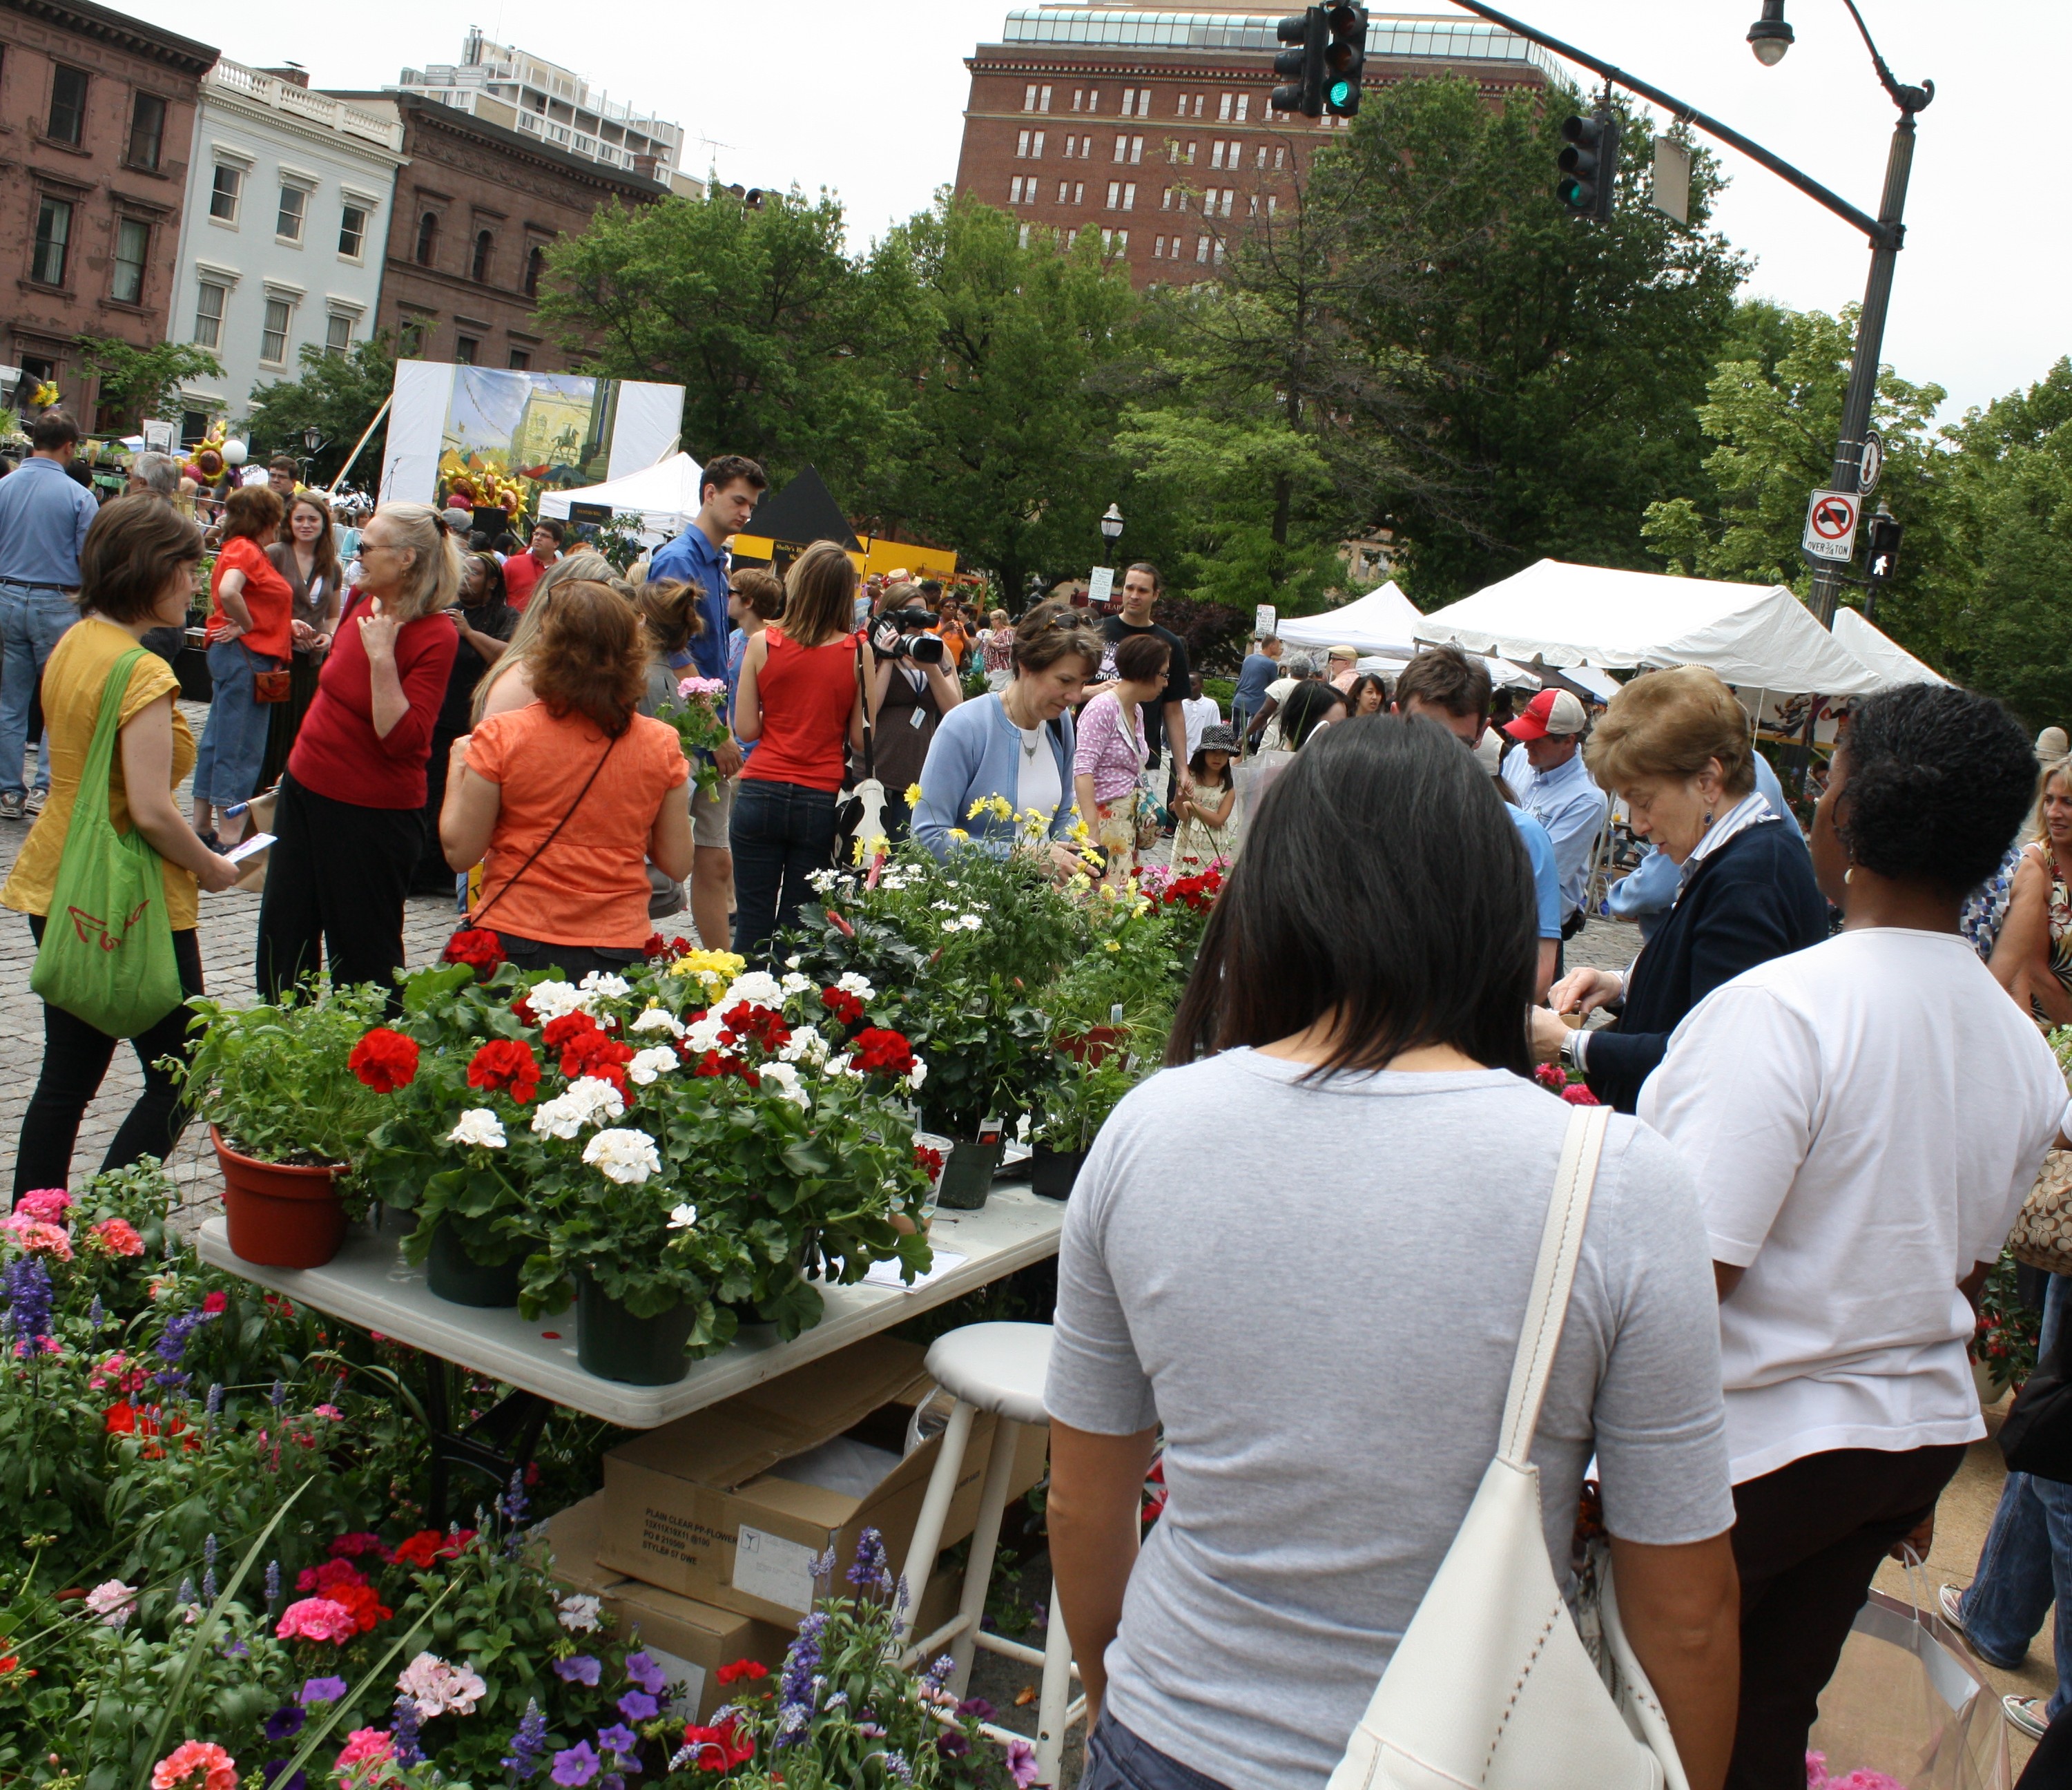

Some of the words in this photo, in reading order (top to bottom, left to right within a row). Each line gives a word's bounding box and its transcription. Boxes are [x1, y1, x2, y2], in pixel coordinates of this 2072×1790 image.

[1807, 541, 1825, 552] OVER
[1834, 545, 1848, 555] TON
[646, 1508, 667, 1521] PLAIN
[668, 1515, 693, 1529] CLEAR
[695, 1524, 738, 1545] PP-FLOWER
[643, 1529, 654, 1539] PO
[690, 1534, 710, 1547] @100
[670, 1549, 679, 1559] 57
[680, 1552, 697, 1565] DWE
